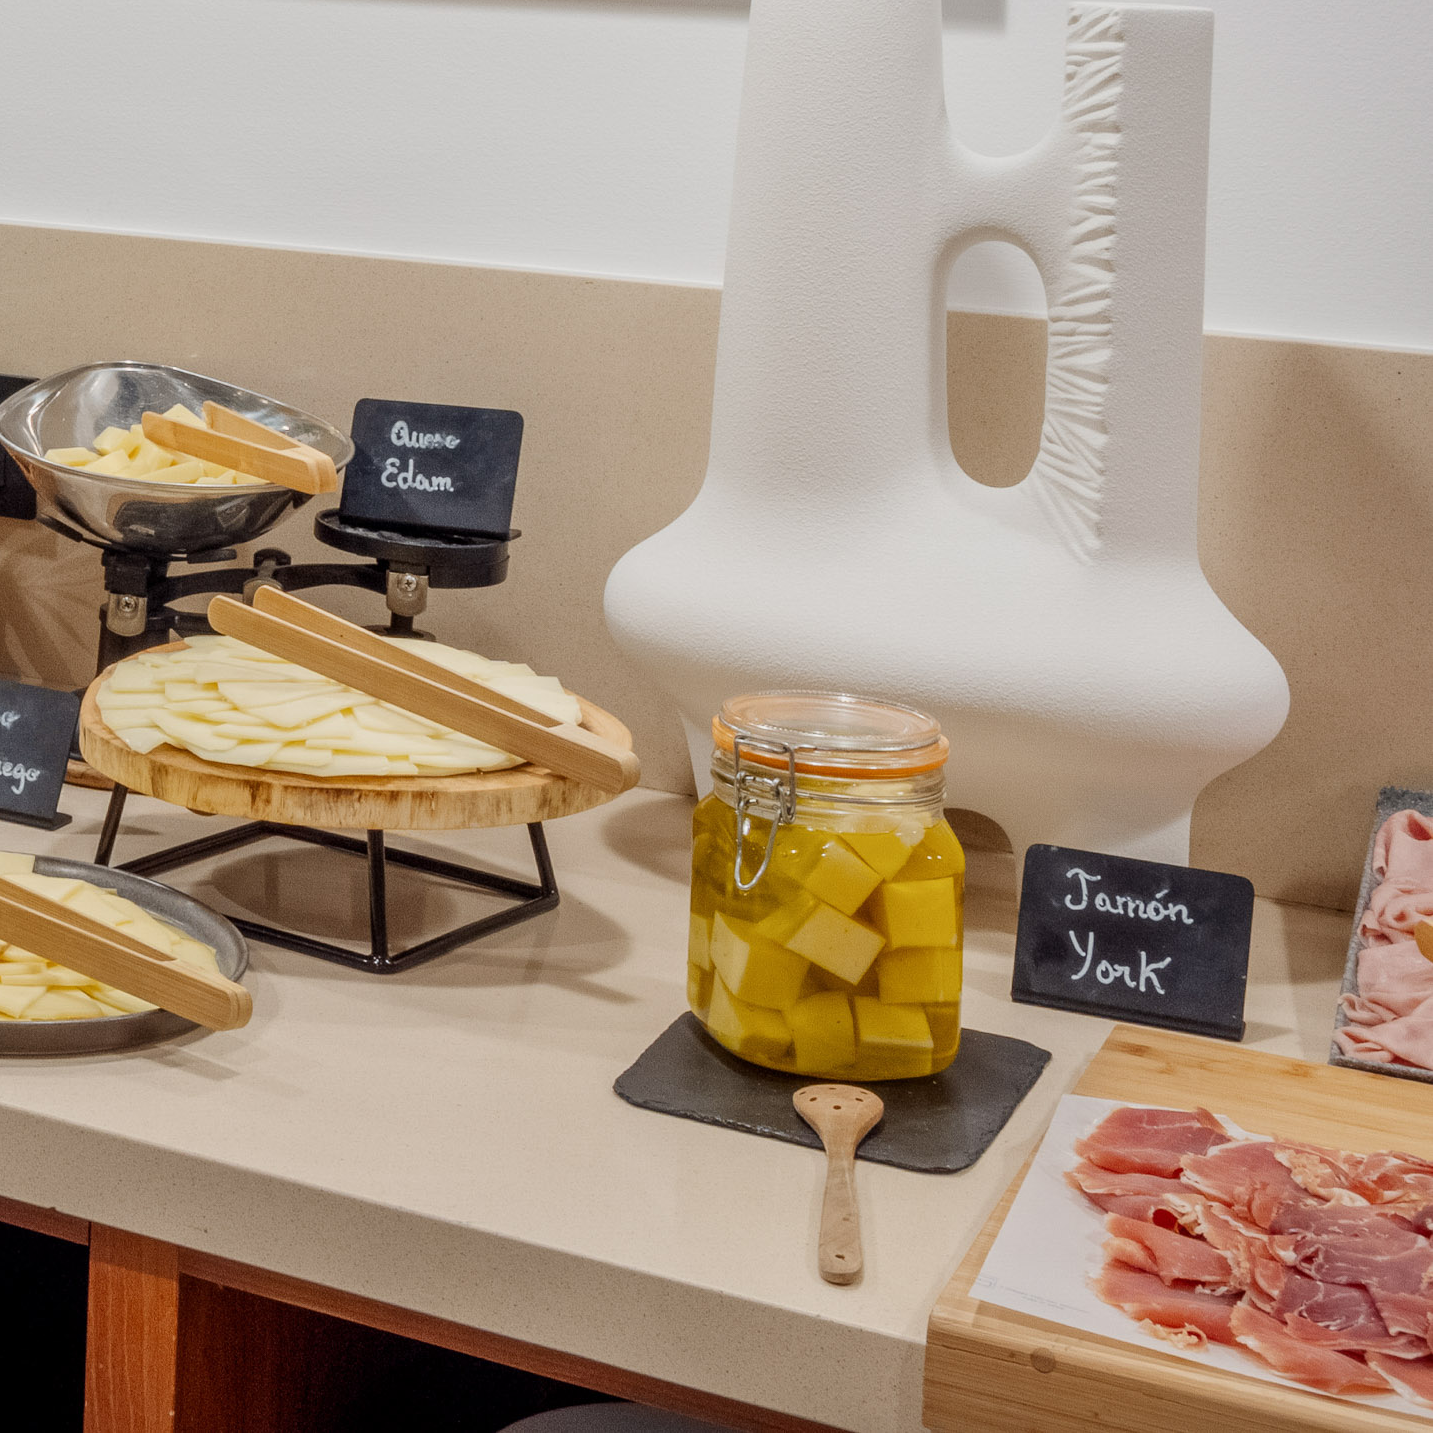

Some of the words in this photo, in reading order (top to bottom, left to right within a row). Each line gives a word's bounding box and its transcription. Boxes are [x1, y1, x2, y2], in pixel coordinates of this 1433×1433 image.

[390, 420, 461, 449] Queso
[380, 457, 454, 492] Edam
[1064, 867, 1194, 924] Jamón
